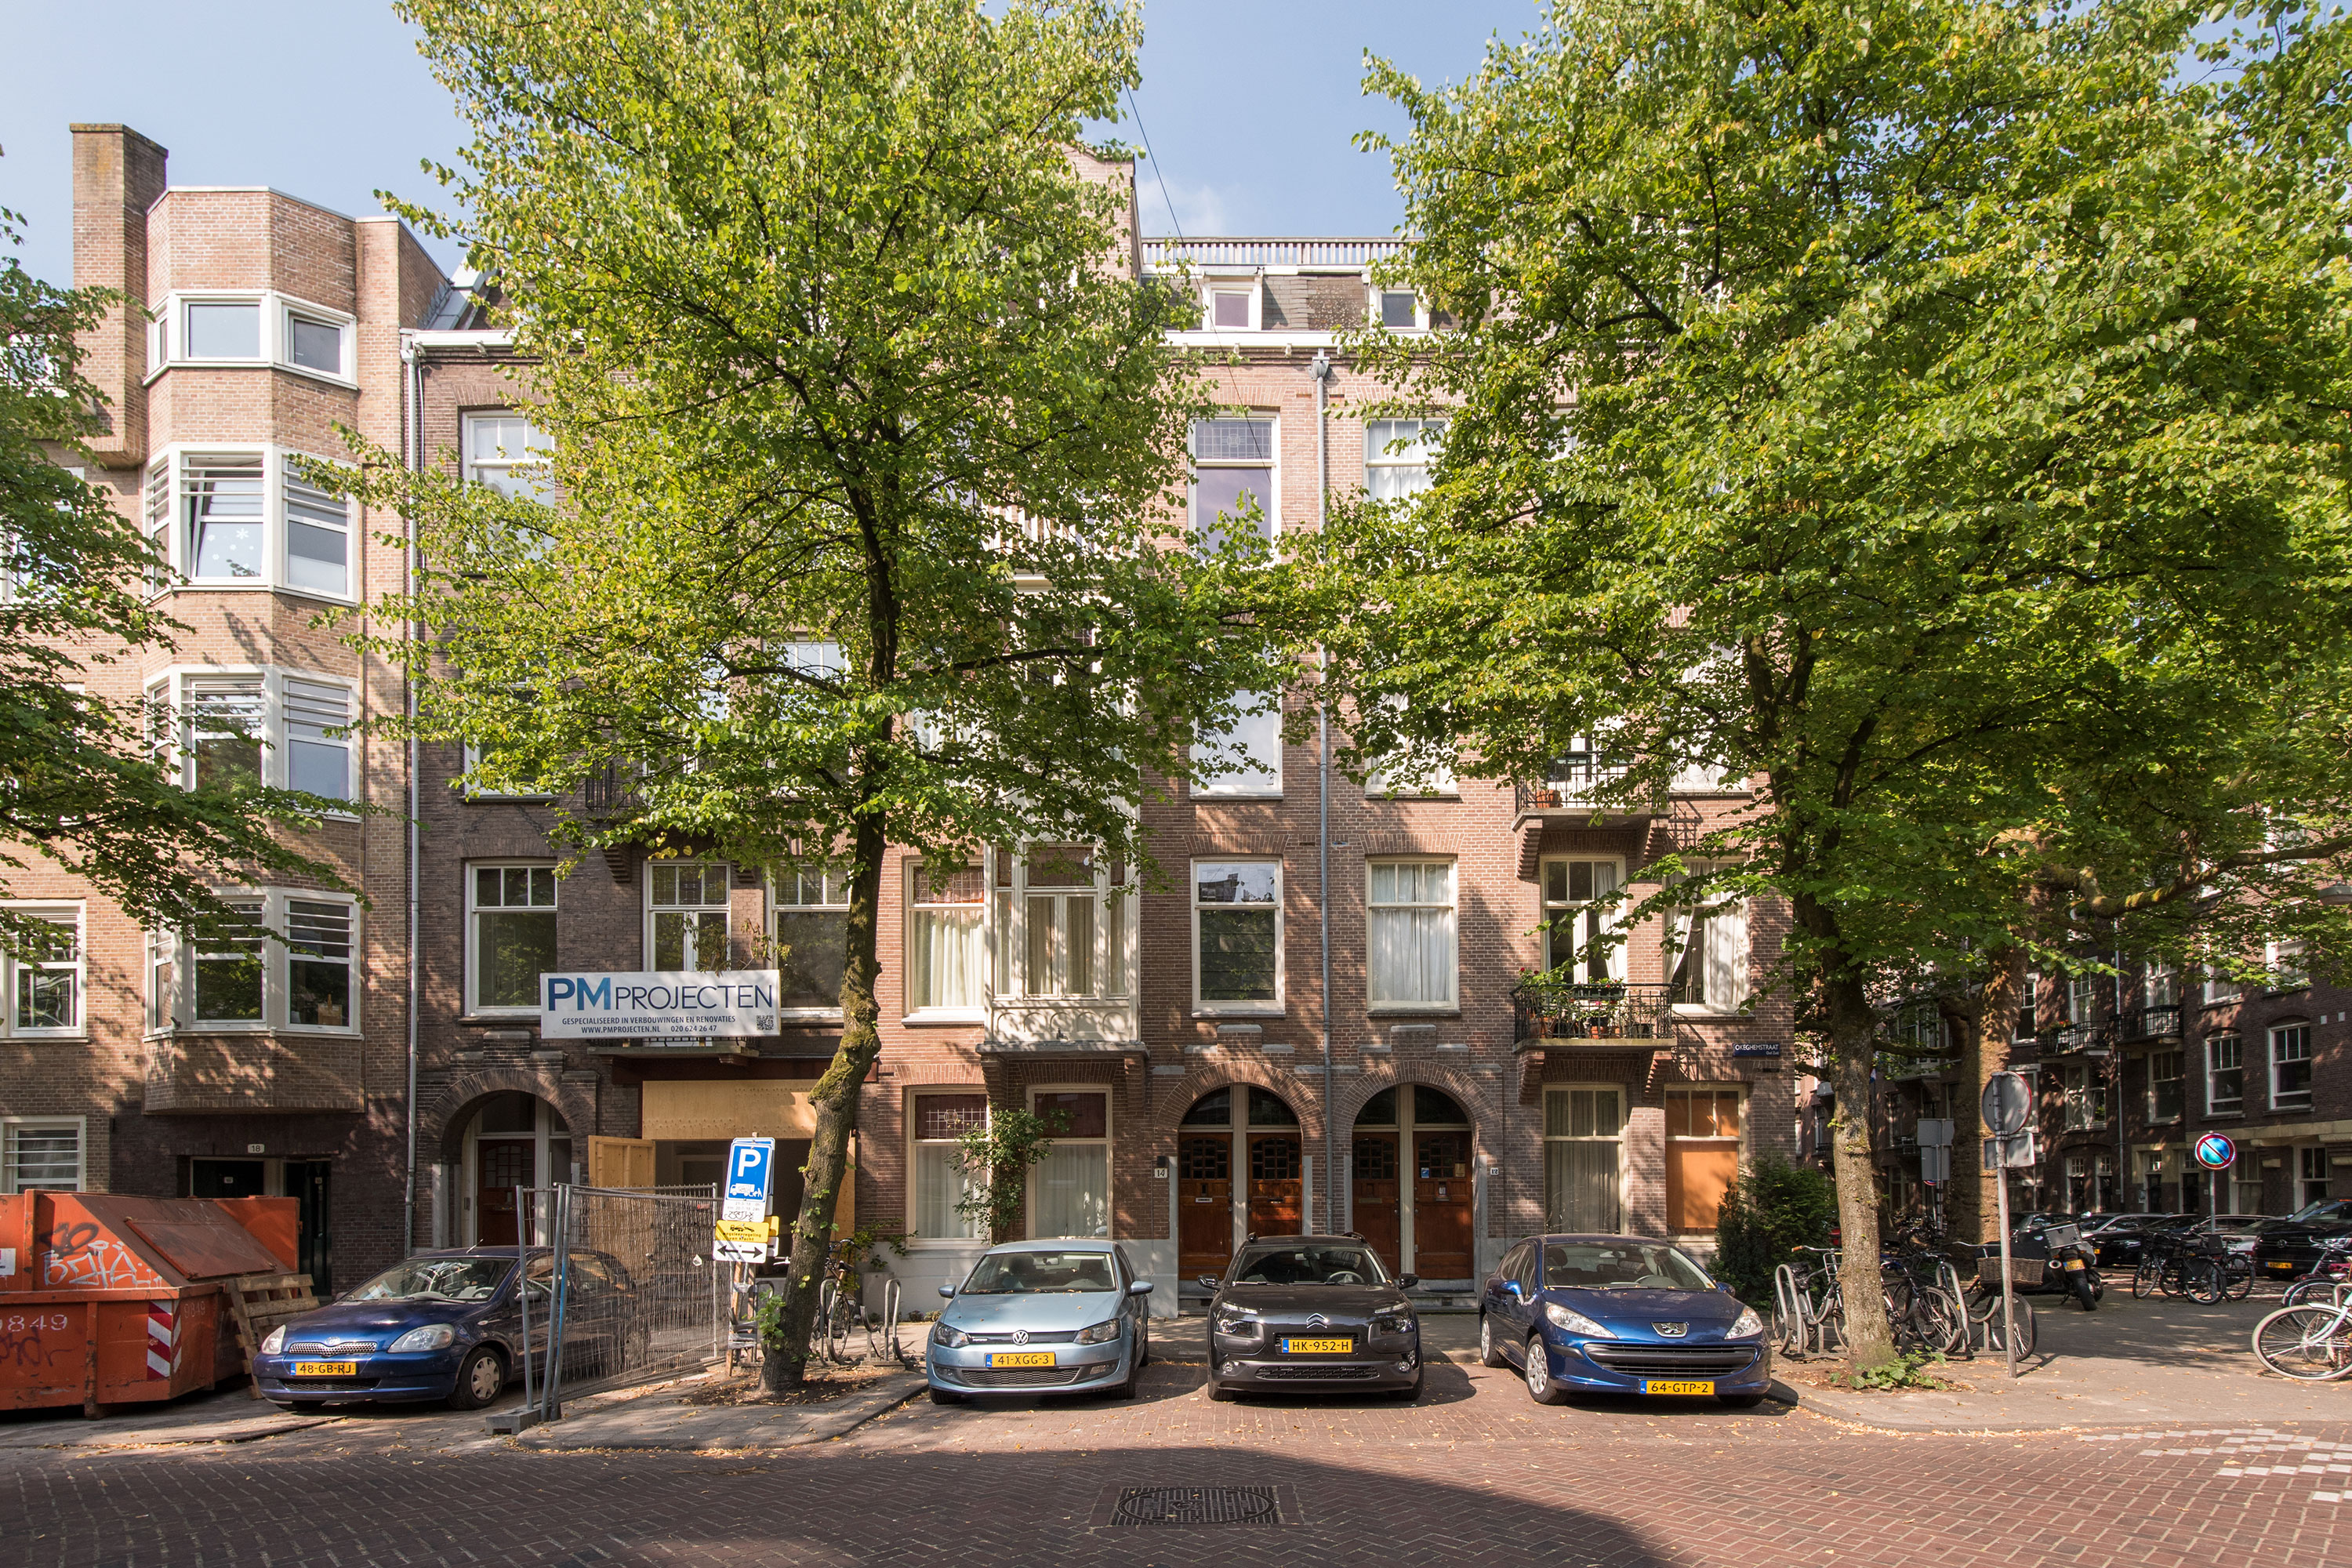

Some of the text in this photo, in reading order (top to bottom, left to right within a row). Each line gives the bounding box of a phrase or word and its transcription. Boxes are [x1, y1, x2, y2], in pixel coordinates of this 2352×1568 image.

[548, 977, 772, 1011] PM PROJECTEN
[737, 1149, 761, 1177] P
[183, 1301, 206, 1319] 9849
[0, 1314, 68, 1332] 849
[1292, 1341, 1348, 1351] HK-952-H
[997, 1355, 1049, 1365] 41-XGG-3
[299, 1364, 351, 1374] 48-GB-RJ
[1651, 1382, 1708, 1392] 64-GTP-2
